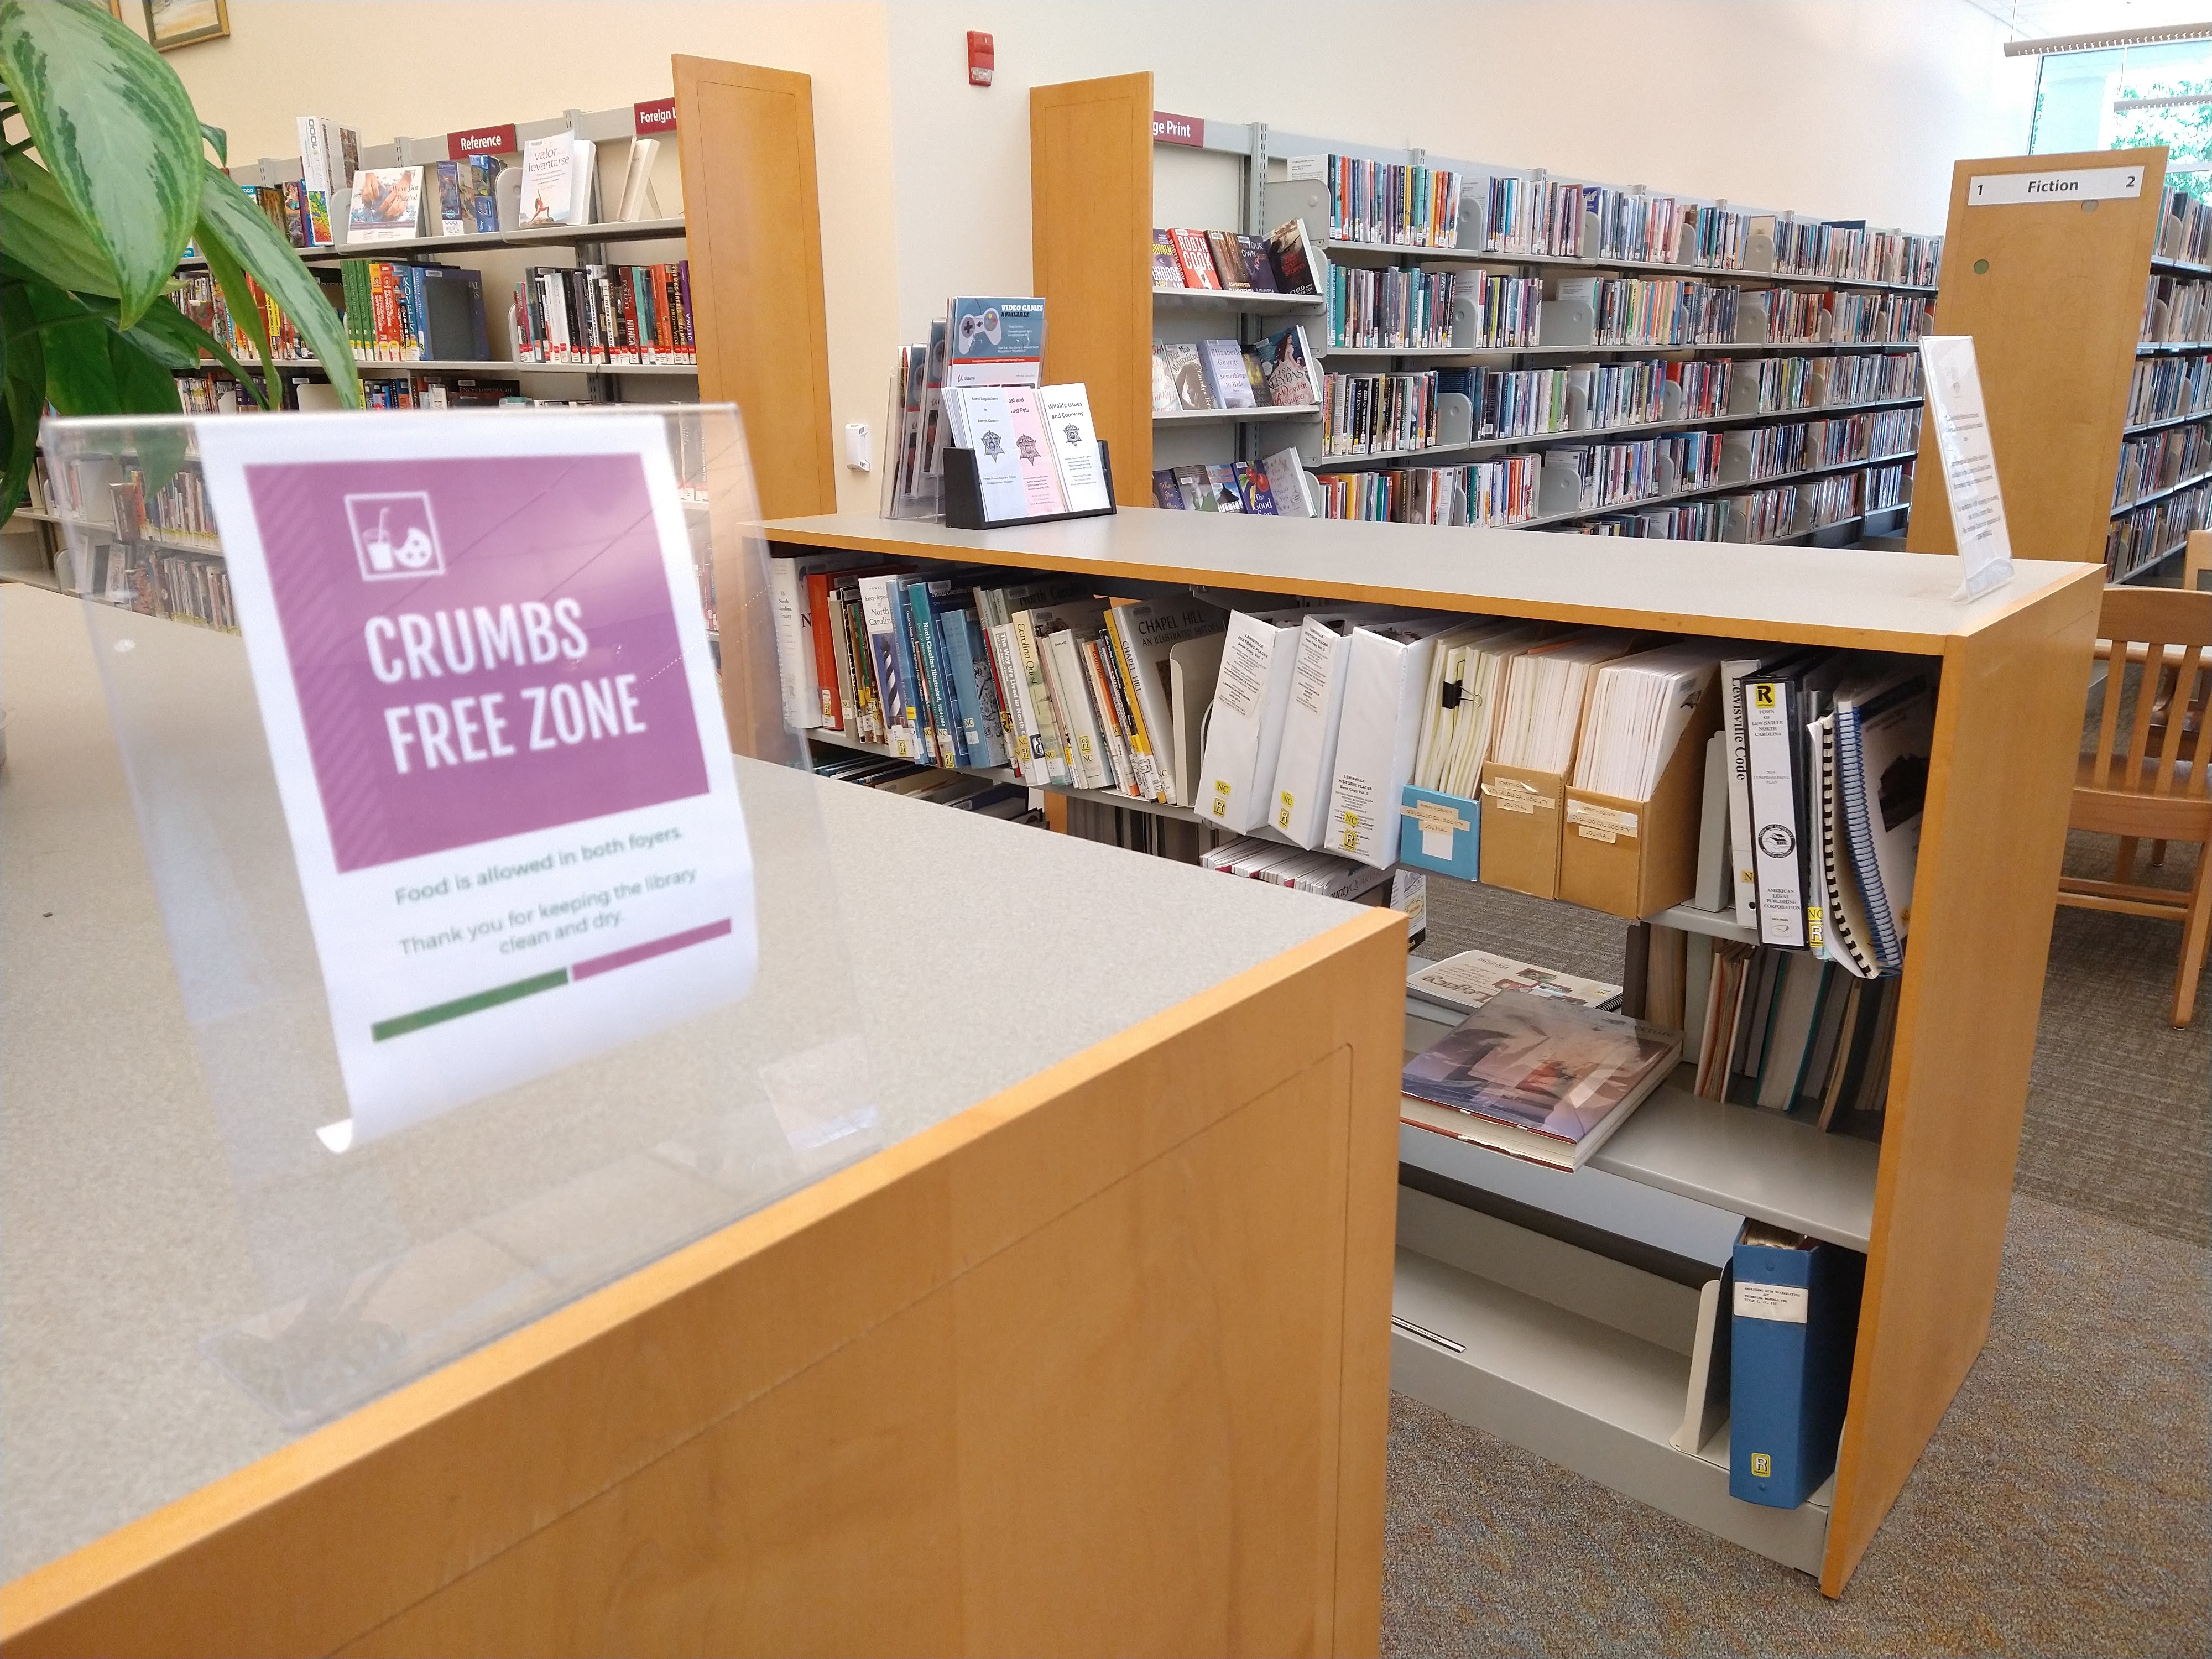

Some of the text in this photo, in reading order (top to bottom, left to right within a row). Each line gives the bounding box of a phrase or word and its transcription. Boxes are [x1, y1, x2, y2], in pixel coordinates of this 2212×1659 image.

[640, 107, 671, 123] Foreign
[309, 119, 319, 149] 1000
[1167, 121, 1190, 137] Print
[461, 134, 502, 150] Reference
[535, 148, 557, 160] valor
[528, 155, 570, 173] levantarse
[1977, 176, 2136, 196] 1 Fiction 2
[1177, 236, 1208, 252] ROBIN
[1183, 251, 1214, 270] COOK
[404, 276, 415, 332] KOVELS
[627, 319, 635, 346] NUNCA
[1211, 348, 1240, 356] Elizabeth
[1269, 369, 1303, 390] KLEYPAS
[1274, 367, 1292, 377] LISA
[1253, 500, 1272, 511] Good
[1255, 494, 1265, 502] The
[1019, 589, 1047, 606] North
[872, 607, 889, 616] North
[1138, 610, 1205, 635] CHAPEL HILL
[364, 597, 589, 684] CRUMBS
[1142, 629, 1192, 646] AN ILLUSTRATED
[1003, 649, 1011, 664] Way
[1018, 623, 1037, 685] Carolina Quest
[927, 641, 935, 668] Carolina
[931, 669, 941, 702] Illustrated,
[1008, 665, 1014, 678] We
[1122, 640, 1141, 696] CHAPEL HILL:
[1010, 679, 1018, 698] Lived
[1757, 685, 1772, 703] R
[383, 673, 647, 774] FREE ZONE
[1016, 708, 1024, 729] North
[1732, 677, 1746, 780] Lewisville Code
[899, 742, 905, 752] R
[1019, 737, 1027, 746] NC
[1082, 738, 1089, 749] R
[945, 754, 952, 765] R
[1045, 751, 1054, 759] NC
[1083, 754, 1093, 763] NC
[1218, 784, 1229, 793] NC
[1216, 801, 1224, 813] R
[1283, 795, 1292, 805] NC
[1281, 811, 1287, 824] R
[1346, 814, 1357, 825] NC
[1347, 833, 1354, 846] R
[1759, 828, 1767, 838] TOWN
[1775, 825, 1794, 839] LEWISVILLE
[395, 827, 682, 905] Food is allowed in both foyers.
[400, 868, 696, 956] Thank you for keeping the library
[499, 928, 550, 956] clean
[554, 918, 588, 939] and
[1811, 926, 1822, 940] R
[1421, 975, 1493, 1004] Legacy
[1755, 1457, 1768, 1472] R
